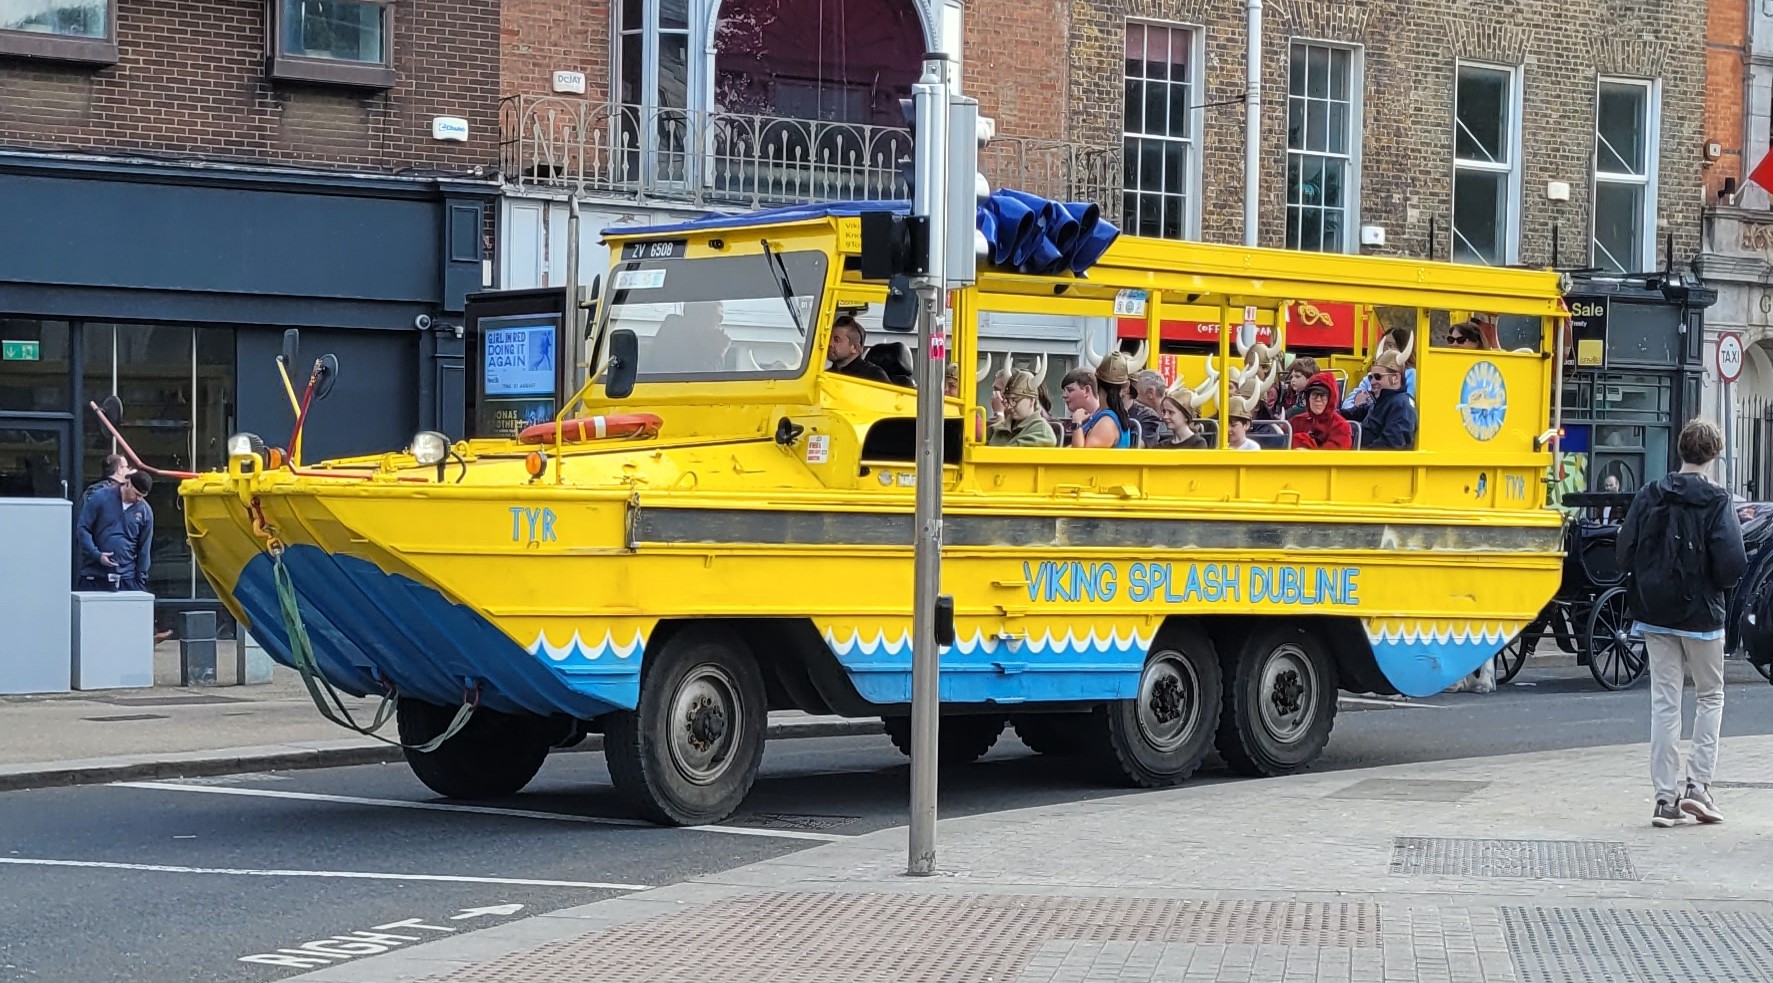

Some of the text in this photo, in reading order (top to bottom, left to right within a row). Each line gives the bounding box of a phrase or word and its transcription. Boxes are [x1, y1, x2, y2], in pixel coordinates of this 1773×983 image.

[631, 242, 673, 258] ZV 6508
[1571, 302, 1604, 317] Sale
[1197, 324, 1232, 334] COFFE
[488, 331, 526, 344] GIRL IN RED
[488, 343, 526, 355] DOING IT
[488, 355, 526, 367] AGAIN
[1721, 351, 1740, 364] TAXI
[508, 507, 557, 542] TYR
[1023, 560, 1118, 602] VIKING
[1129, 562, 1241, 603] SPLASH
[238, 917, 457, 968] RIGHT
